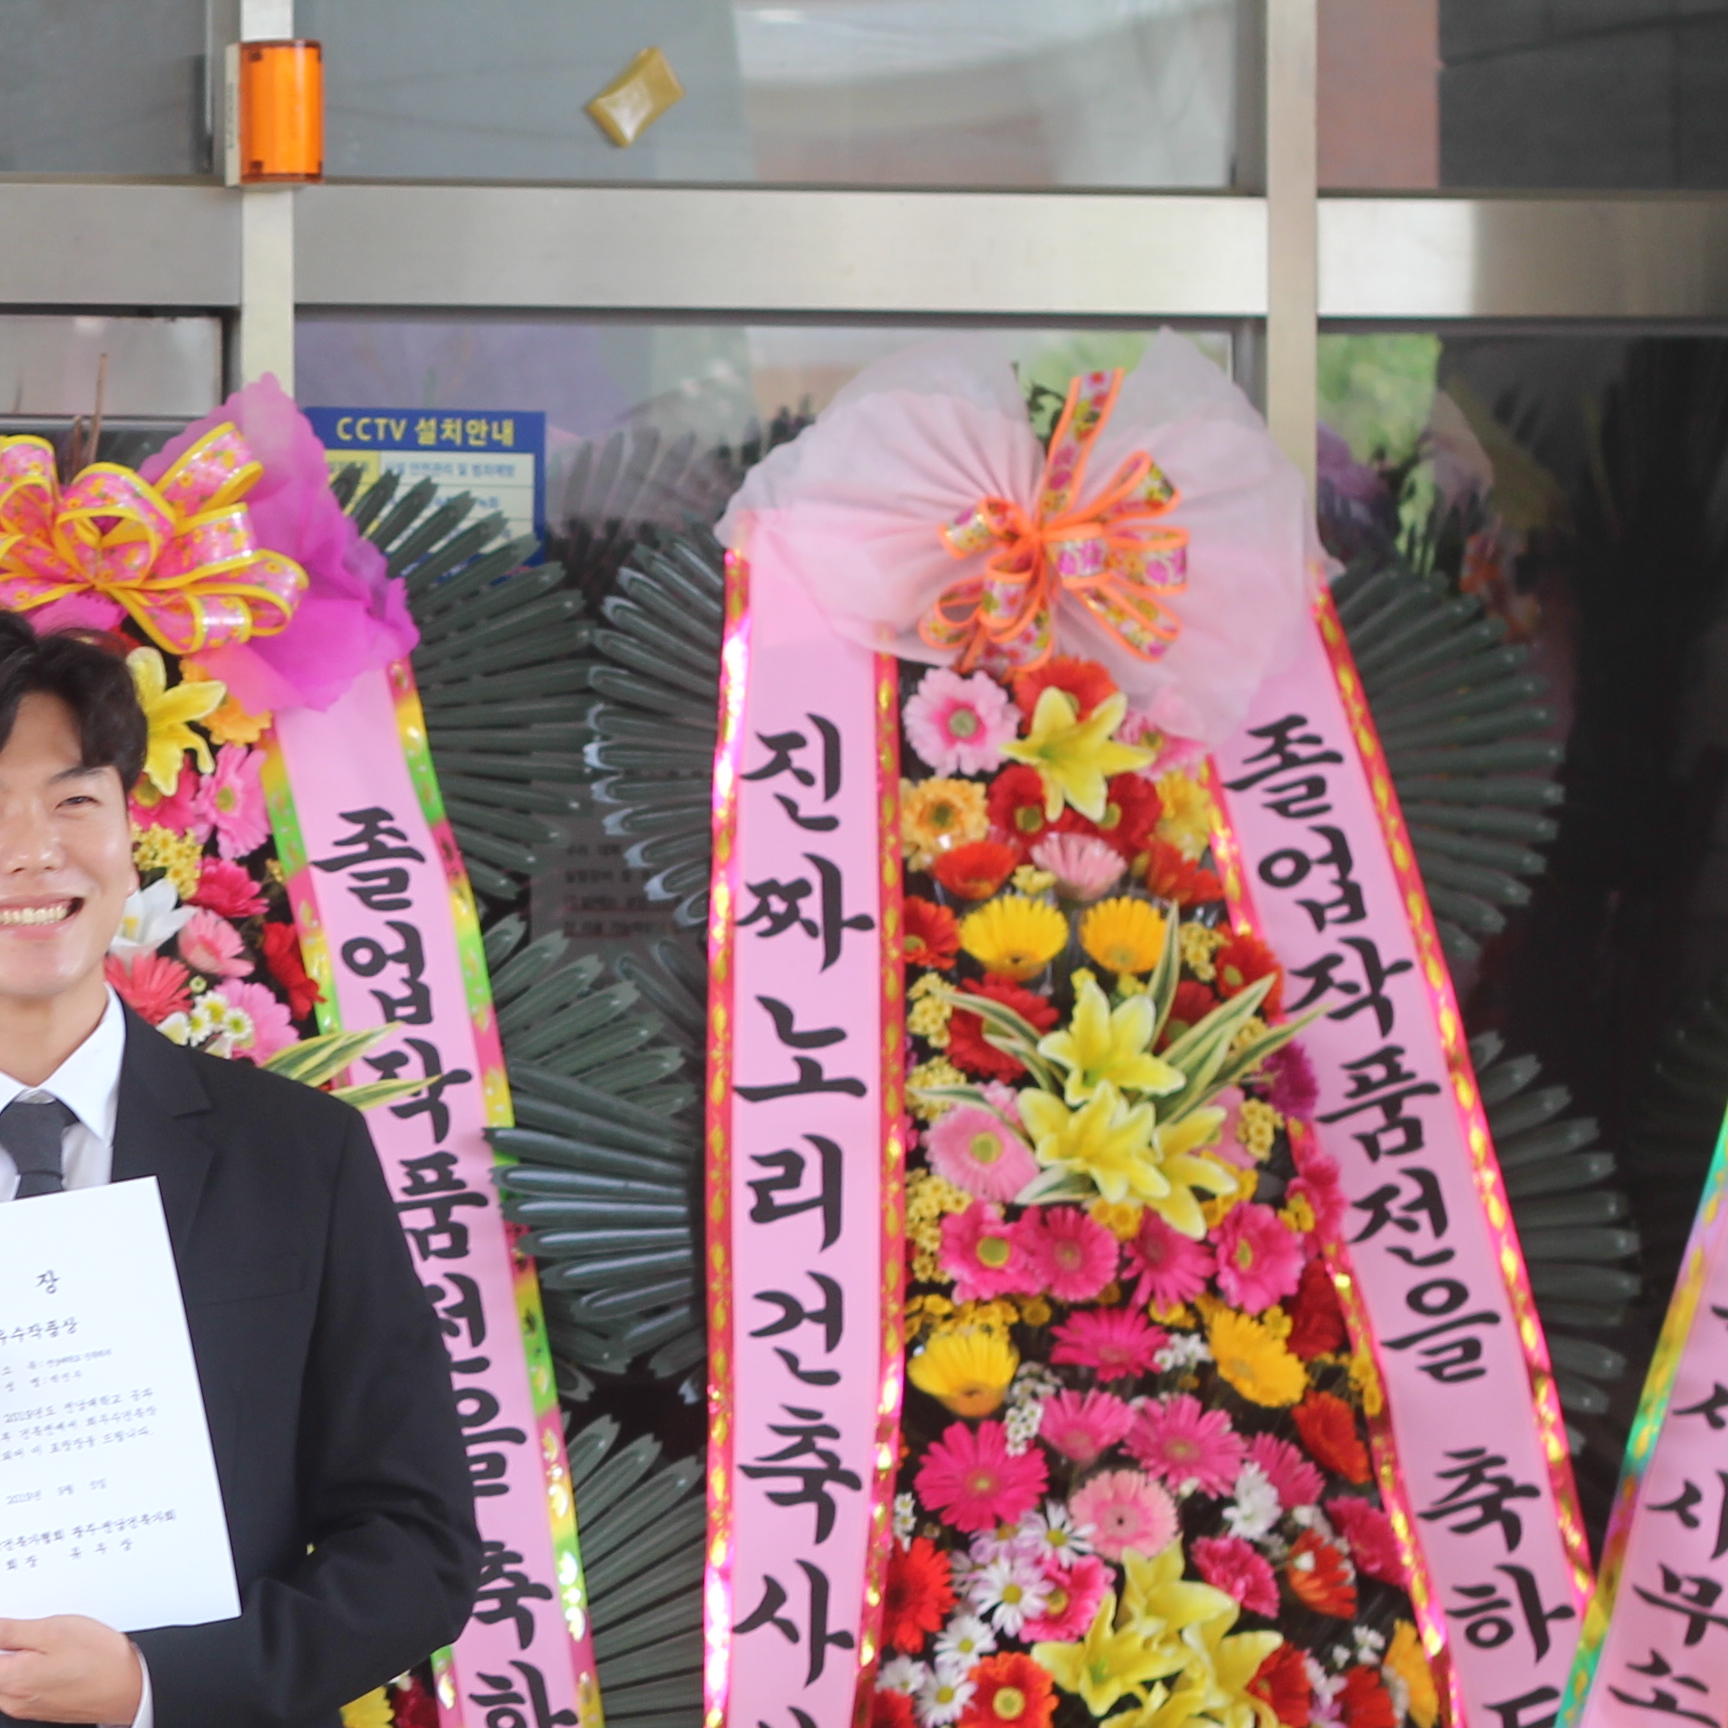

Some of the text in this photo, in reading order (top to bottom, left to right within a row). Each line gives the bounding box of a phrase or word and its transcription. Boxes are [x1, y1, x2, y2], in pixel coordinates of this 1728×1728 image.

[336, 417, 515, 447] CCTV 설치안내
[1224, 714, 1501, 1384] 졸업작품전을
[35, 1269, 60, 1295] 장
